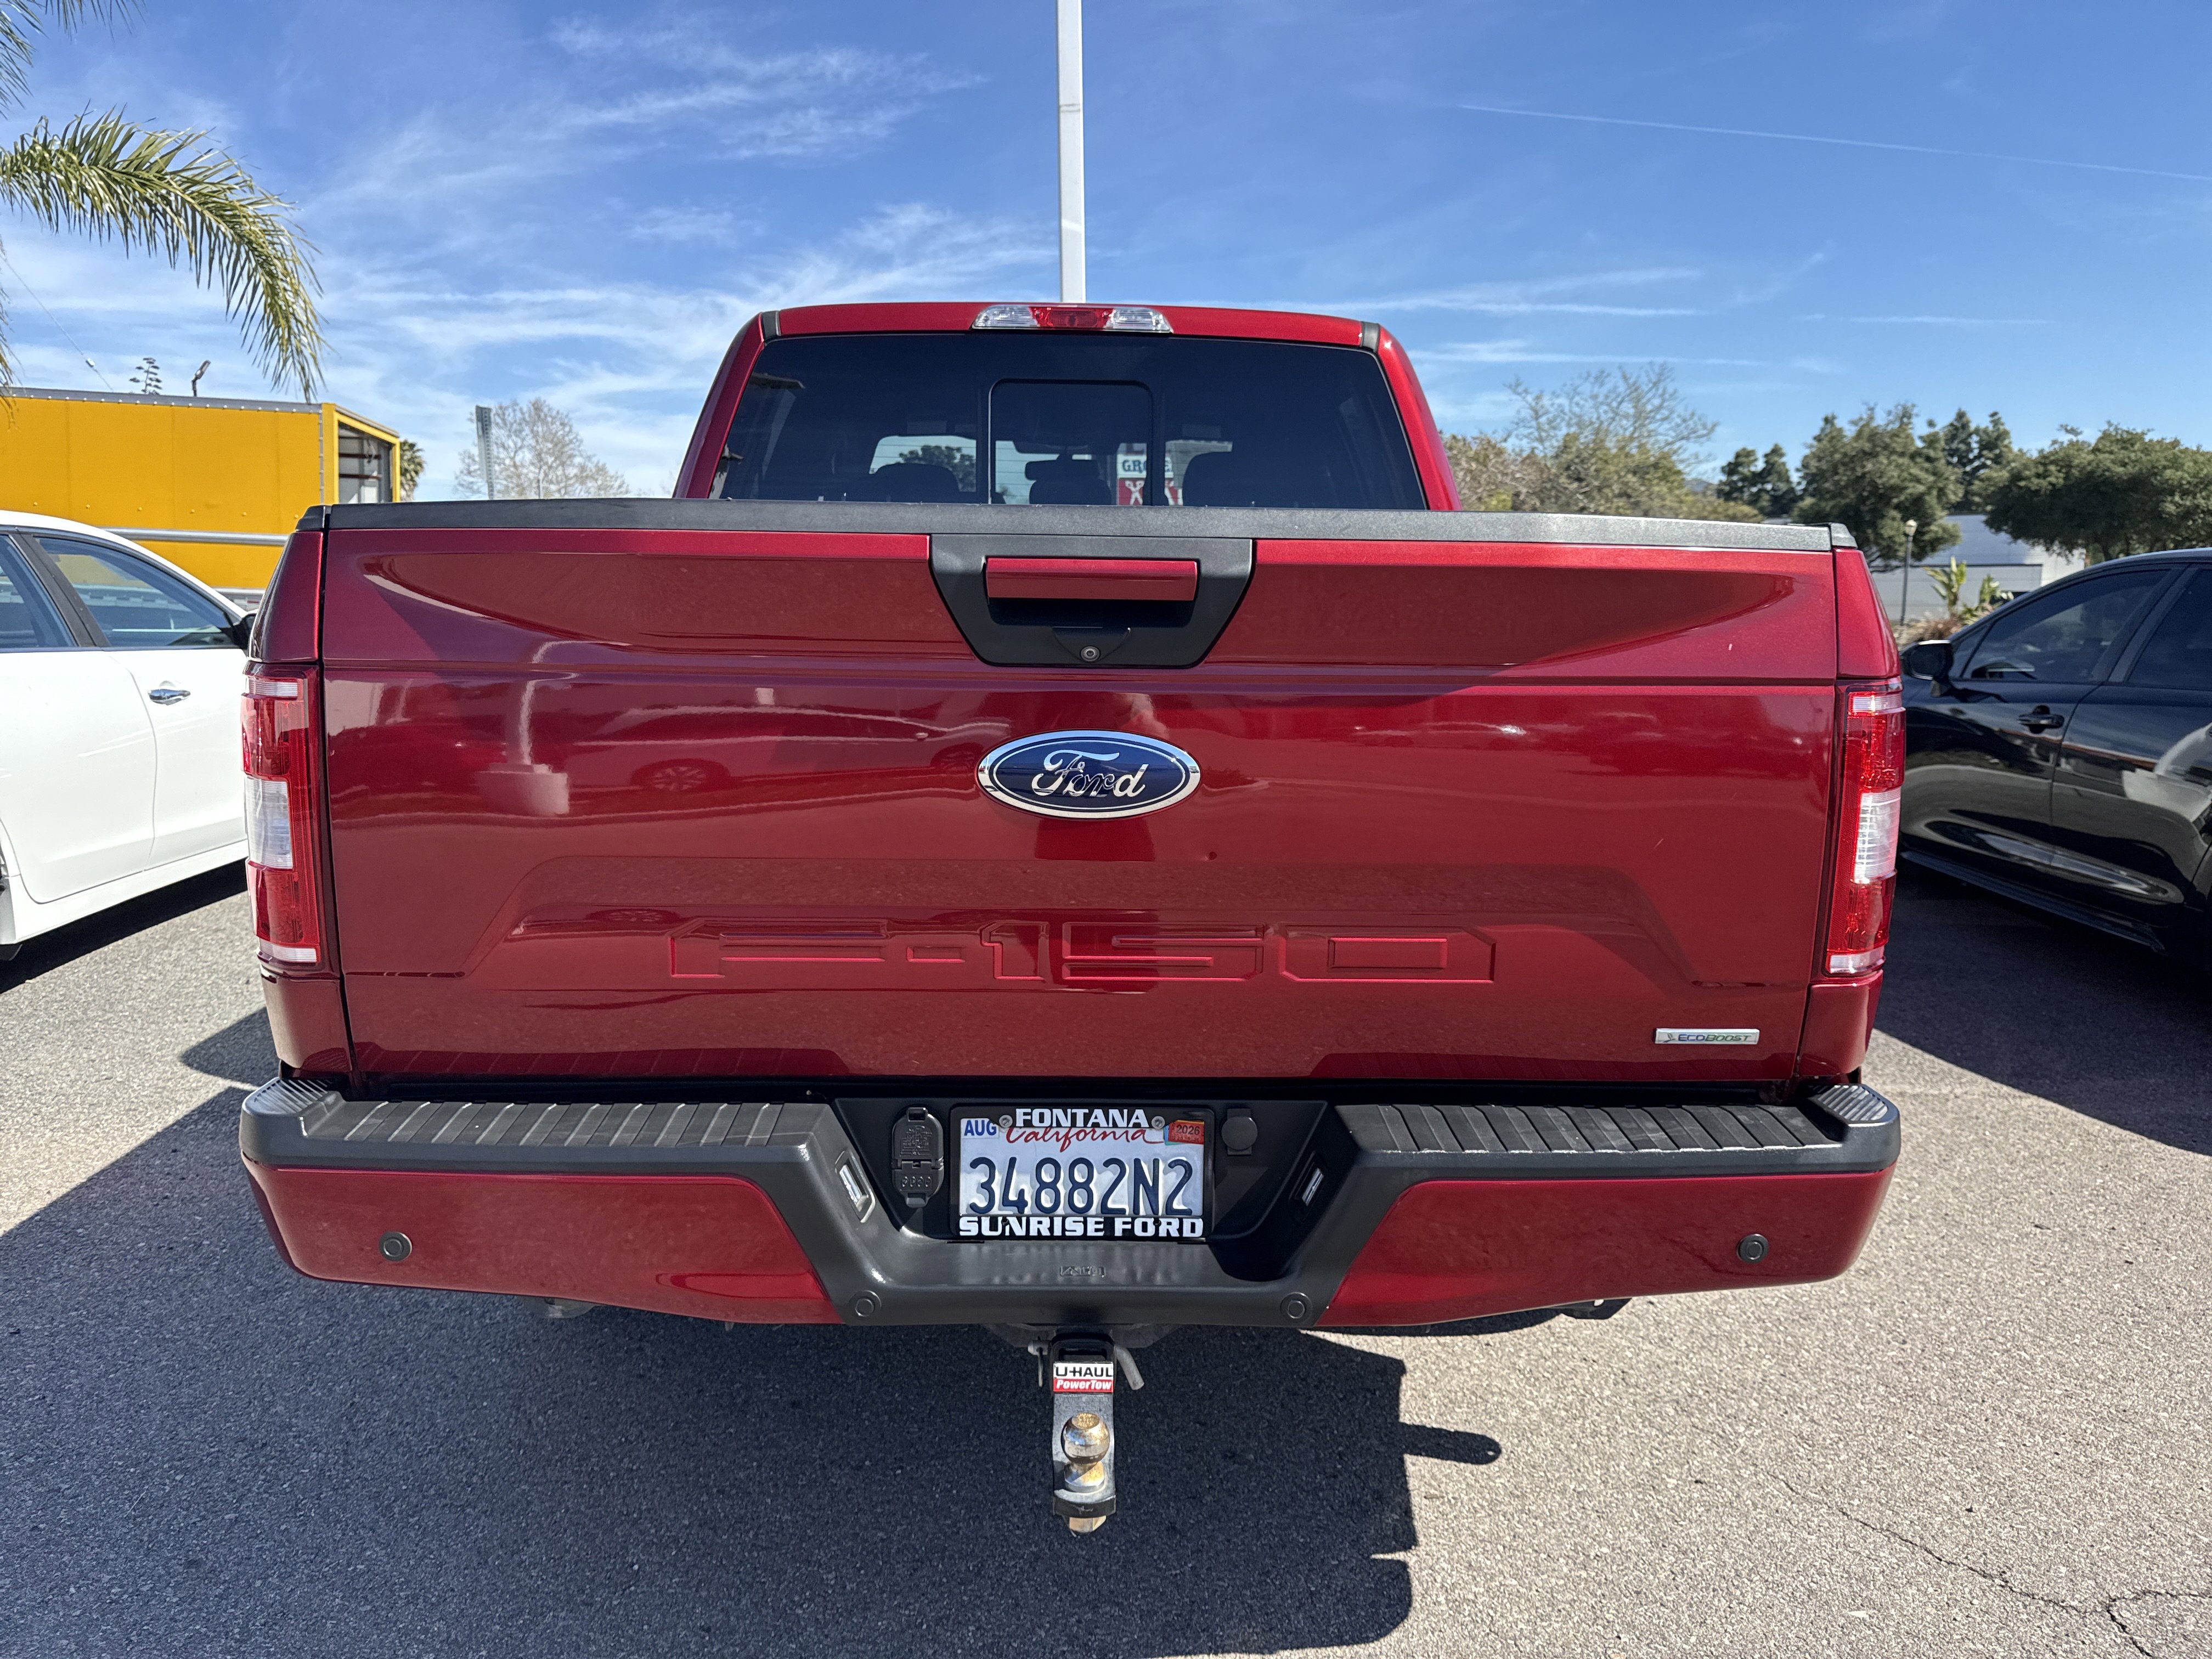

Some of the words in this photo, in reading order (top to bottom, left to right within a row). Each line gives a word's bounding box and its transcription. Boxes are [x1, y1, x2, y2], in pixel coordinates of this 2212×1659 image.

[1031, 749, 1149, 797] Ford
[670, 918, 1494, 983] F-150
[1678, 1034, 1752, 1042] ECOBOOST
[964, 1119, 997, 1136] AUG
[1015, 1108, 1150, 1128] FONTANA
[1006, 1127, 1164, 1152] California
[1176, 1124, 1200, 1136] 2026
[968, 1156, 1194, 1215] 34882N2
[959, 1216, 1105, 1237] SUNRISE
[1114, 1217, 1204, 1238] FORD
[1056, 1367, 1113, 1378] U-HAUL
[1056, 1379, 1113, 1390] PowerTow
